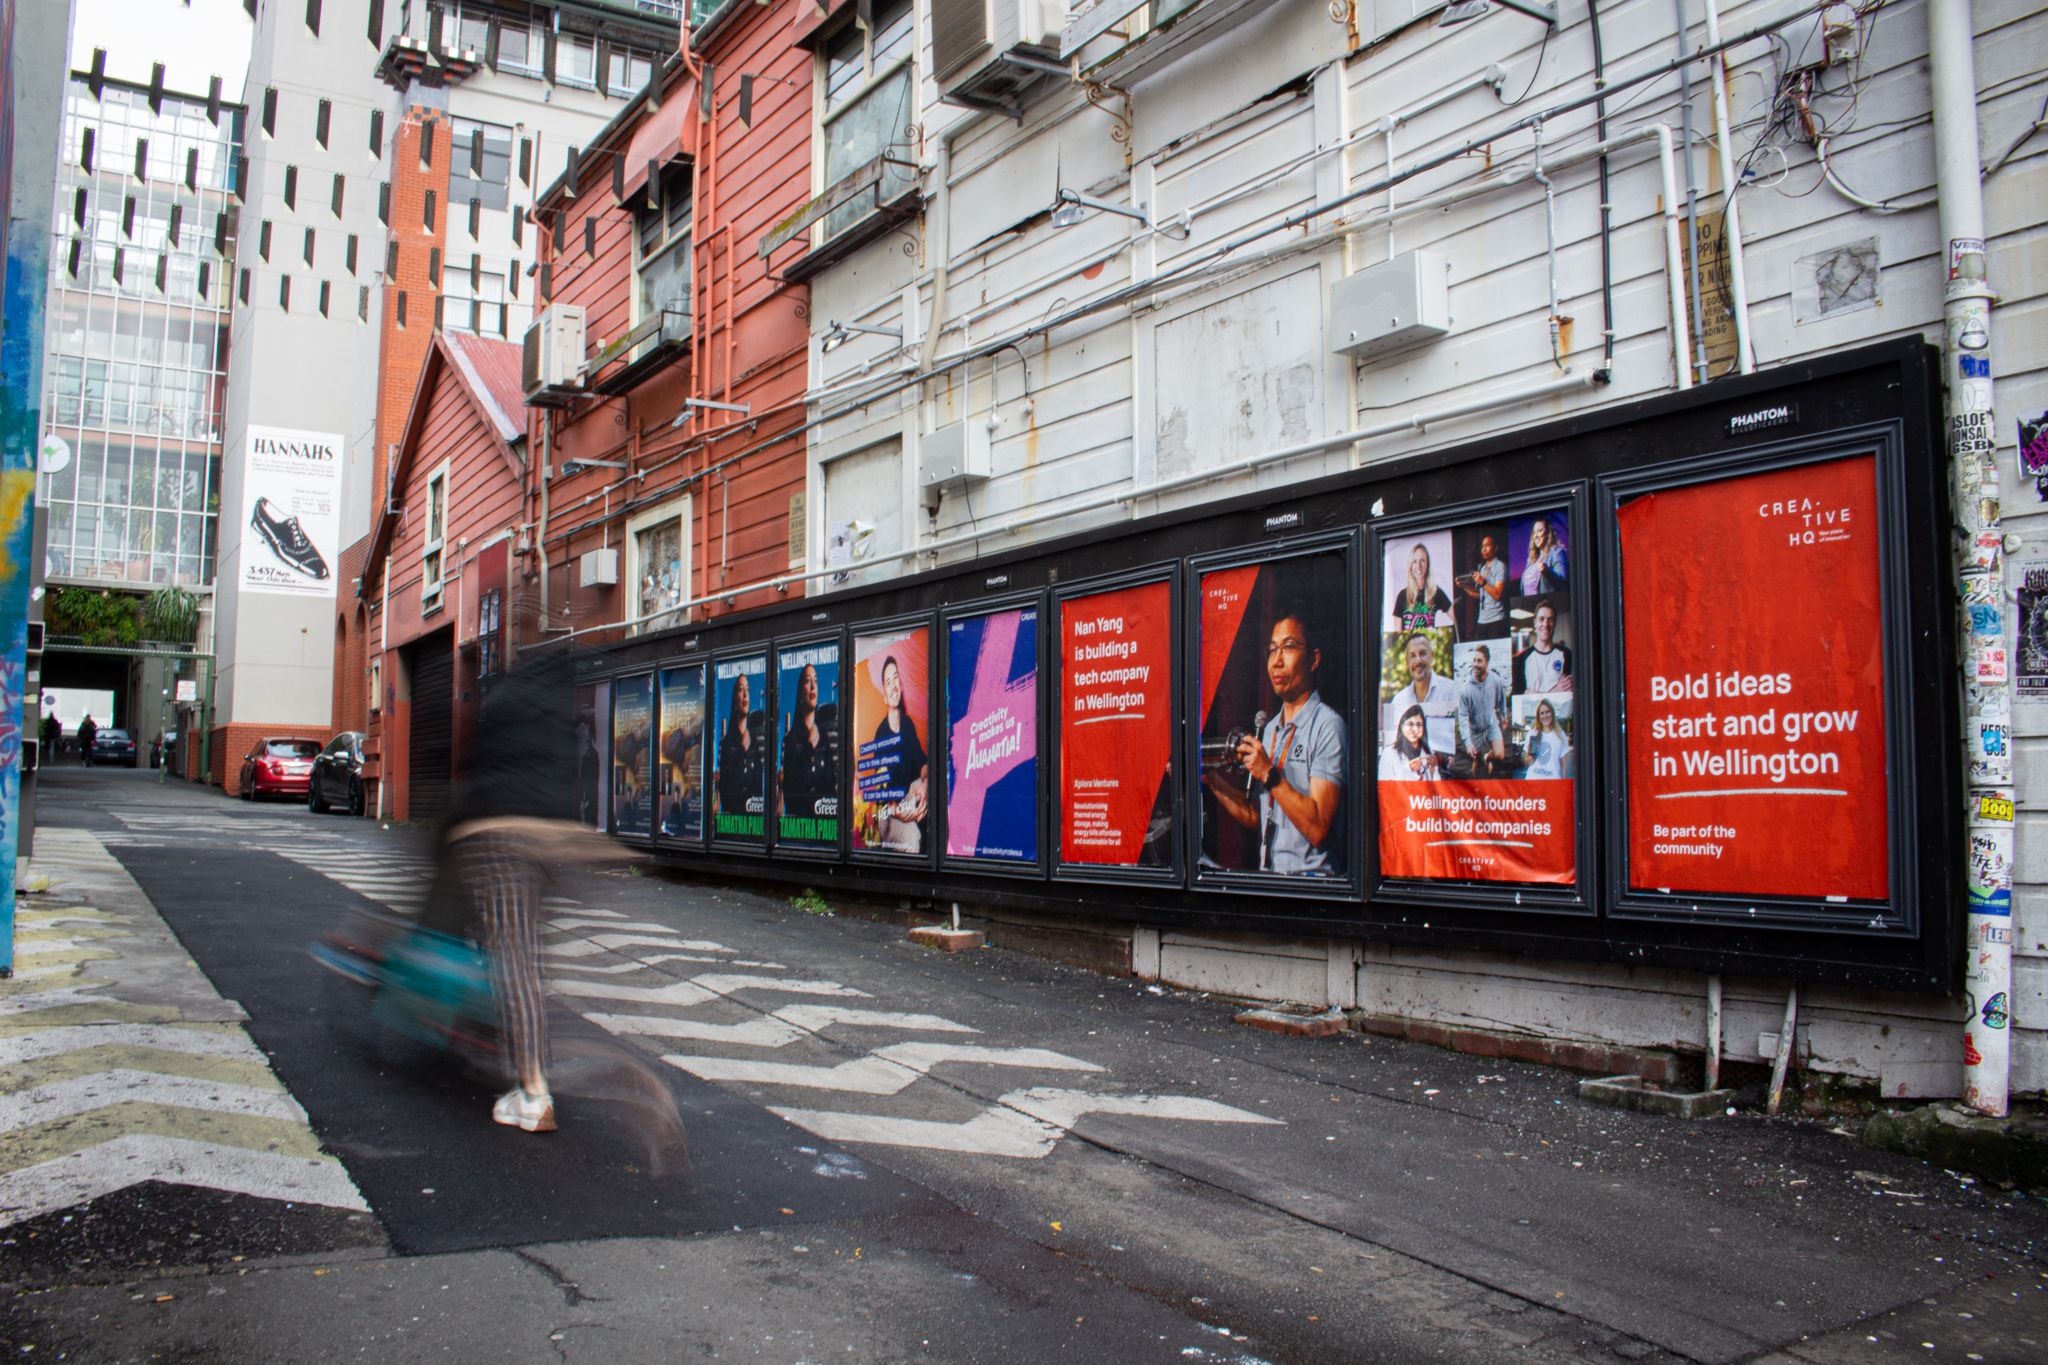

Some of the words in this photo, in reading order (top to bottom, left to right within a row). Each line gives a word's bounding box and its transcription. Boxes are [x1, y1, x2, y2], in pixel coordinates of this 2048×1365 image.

[1681, 236, 1728, 264] STPPING
[1708, 264, 1731, 284] NIGH
[1731, 406, 1788, 428] PHANTOM
[254, 438, 333, 461] HANNAHS
[1266, 513, 1297, 526] PHANTOM
[1802, 508, 1851, 527] TIVE
[1789, 531, 1815, 546] HQ
[1075, 621, 1095, 636] Nan
[1097, 617, 1123, 634] Yang
[781, 648, 818, 670] WELLINGTON
[1075, 646, 1084, 661] is
[1086, 641, 1128, 659] building
[1130, 641, 1137, 653] a
[718, 659, 750, 680] WELLINGTON
[1075, 670, 1098, 686] tech
[1100, 666, 1150, 685] company
[1651, 673, 1708, 701] Bold
[1716, 671, 1791, 698] ideas
[1075, 697, 1085, 711] in
[1086, 692, 1144, 711] Wellington
[970, 707, 1008, 735] Creativity
[979, 722, 1004, 743] makes
[1006, 716, 1015, 729] us
[1652, 713, 1717, 739] start
[1723, 709, 1775, 736] and
[1783, 710, 1858, 742] grow
[1653, 752, 1677, 776] in
[1682, 749, 1839, 782] Wellington
[1409, 795, 1481, 814] Wellington
[1484, 796, 1547, 811] founders
[716, 815, 747, 835] TAMATHA
[780, 816, 817, 839] TAMATHA
[1406, 817, 1442, 832] build
[1443, 819, 1473, 833] bold
[1475, 820, 1551, 838] companies
[1654, 825, 1669, 837] Be
[1671, 825, 1696, 840] part
[1699, 825, 1713, 838] of
[1714, 825, 1736, 838] the
[1653, 843, 1723, 859] community
